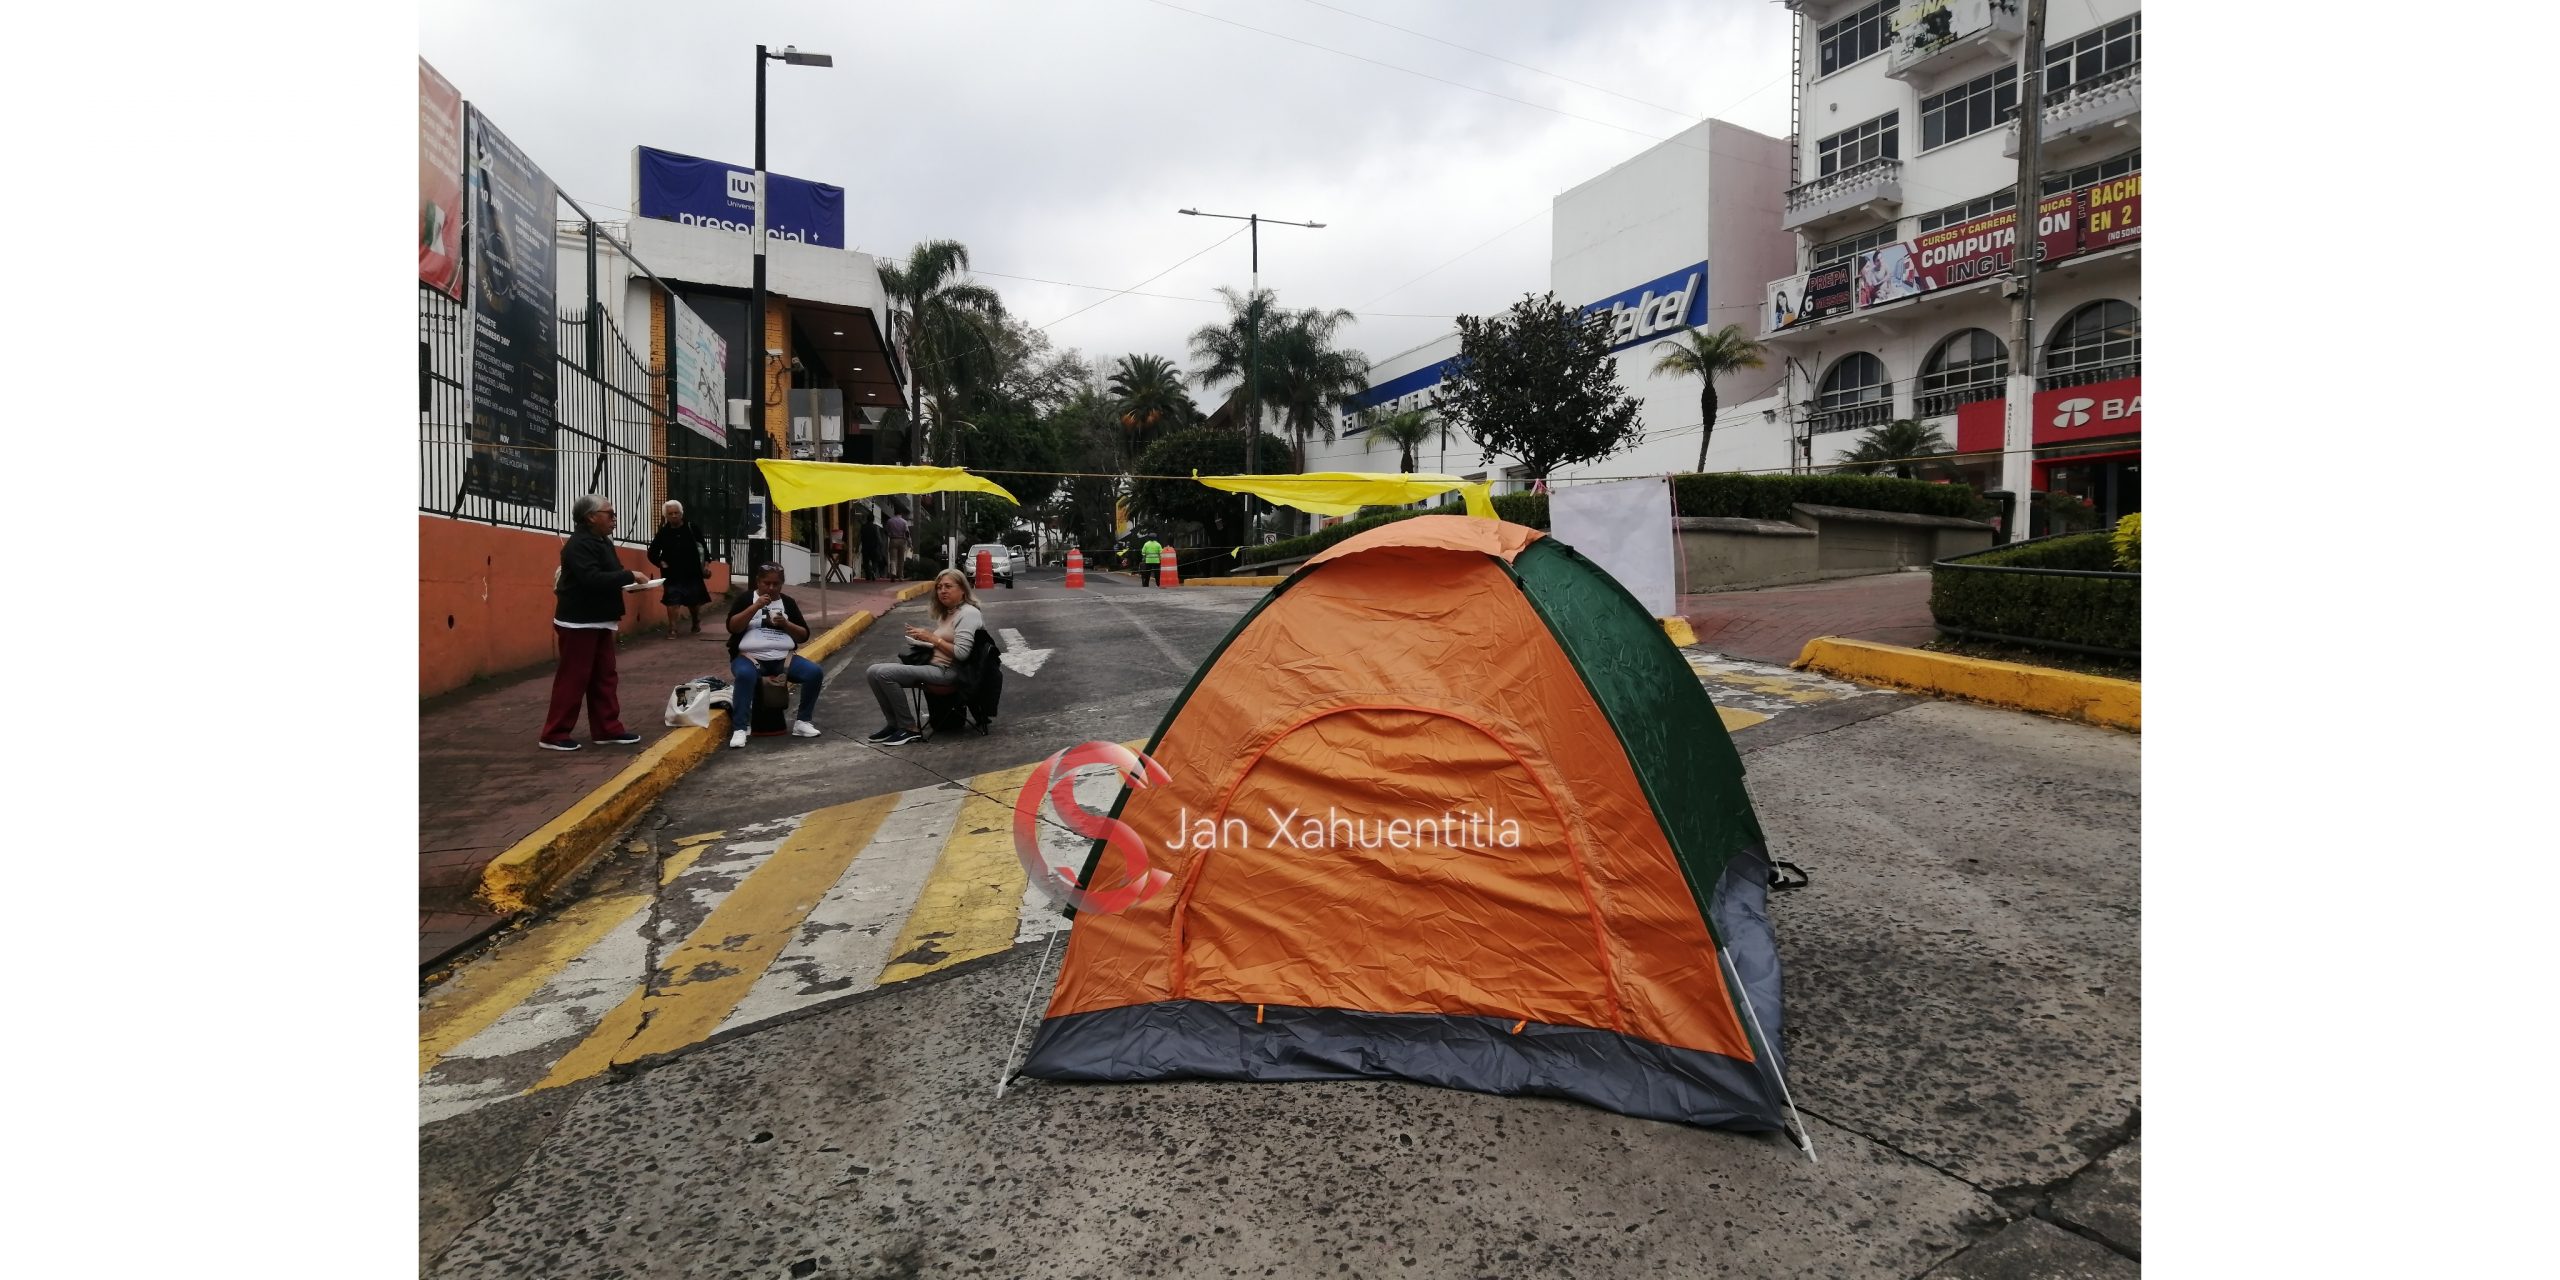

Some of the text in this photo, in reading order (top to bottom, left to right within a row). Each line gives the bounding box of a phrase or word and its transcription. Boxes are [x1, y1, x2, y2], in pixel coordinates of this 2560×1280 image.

[1922, 230, 1958, 247] CURSOS
[1960, 227, 1967, 237] Y
[1968, 212, 2017, 235] CARRERAS
[2090, 204, 2132, 233] EN 2
[1921, 210, 2071, 268] COMPUTAÓN
[1946, 241, 2048, 285] INGLS
[1808, 268, 1849, 293] PREPA
[1804, 295, 1814, 312] 6
[476, 323, 501, 342] CONGRESO
